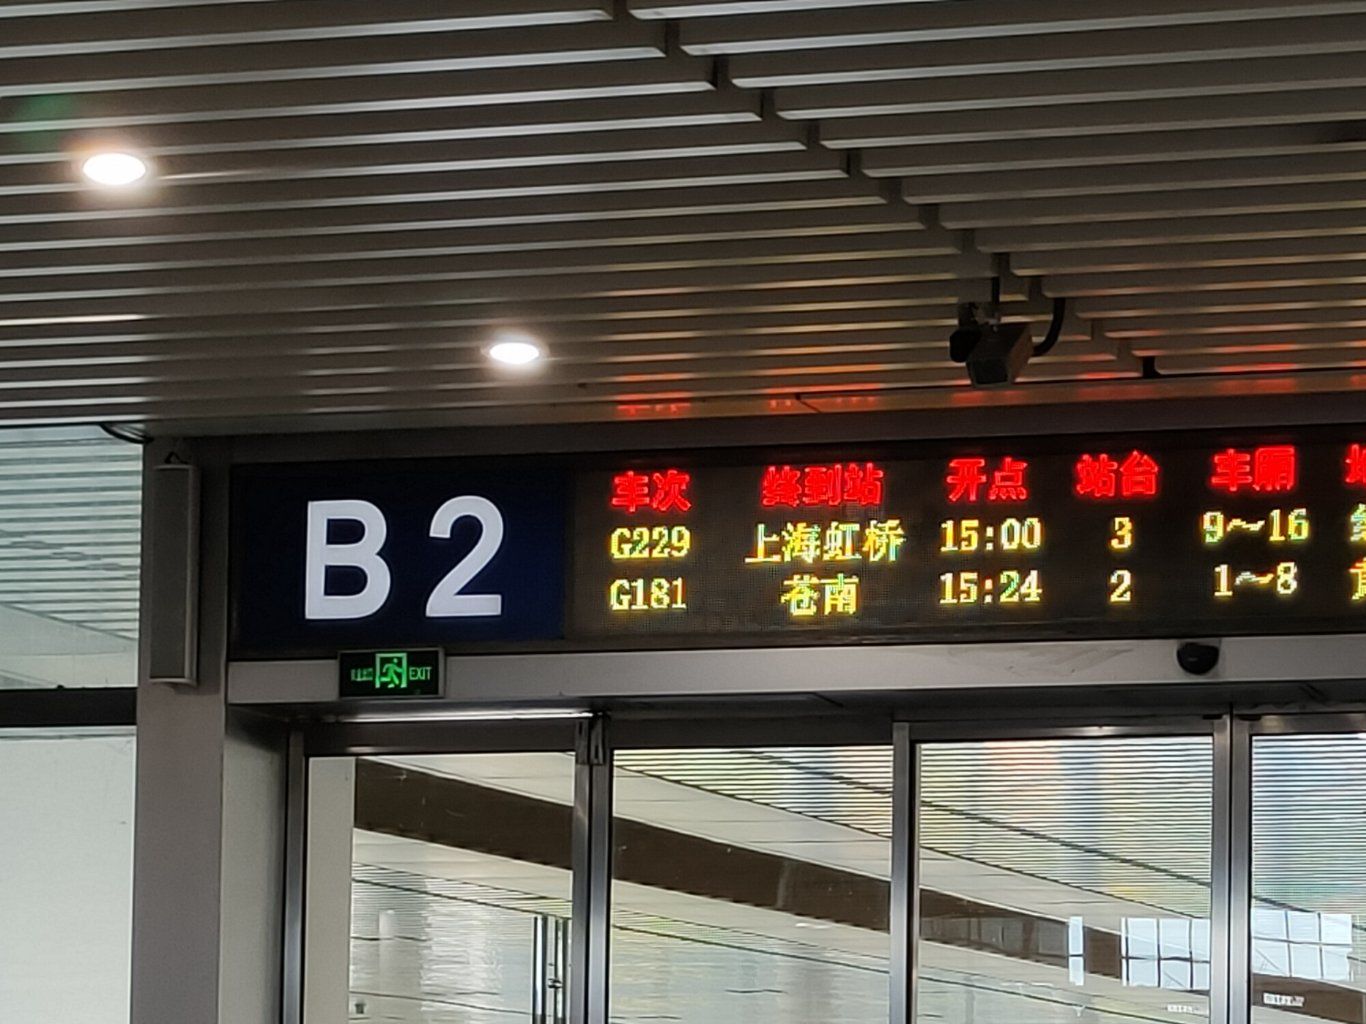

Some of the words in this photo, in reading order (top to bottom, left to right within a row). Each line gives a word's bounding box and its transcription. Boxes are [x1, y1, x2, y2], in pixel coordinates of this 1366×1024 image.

[611, 469, 692, 513] 车次
[761, 461, 885, 508] 终到站
[947, 456, 1029, 502] 开点
[1075, 450, 1160, 498] 站台
[610, 525, 691, 560] G229
[744, 518, 906, 564] 上海虹桥
[940, 517, 1042, 553] 15:00
[1110, 516, 1133, 549] 3
[610, 576, 688, 611] G181
[780, 572, 860, 617] 苍南
[939, 569, 1043, 604] 15:24
[1110, 569, 1132, 602] 2
[409, 666, 432, 681] EXIT
